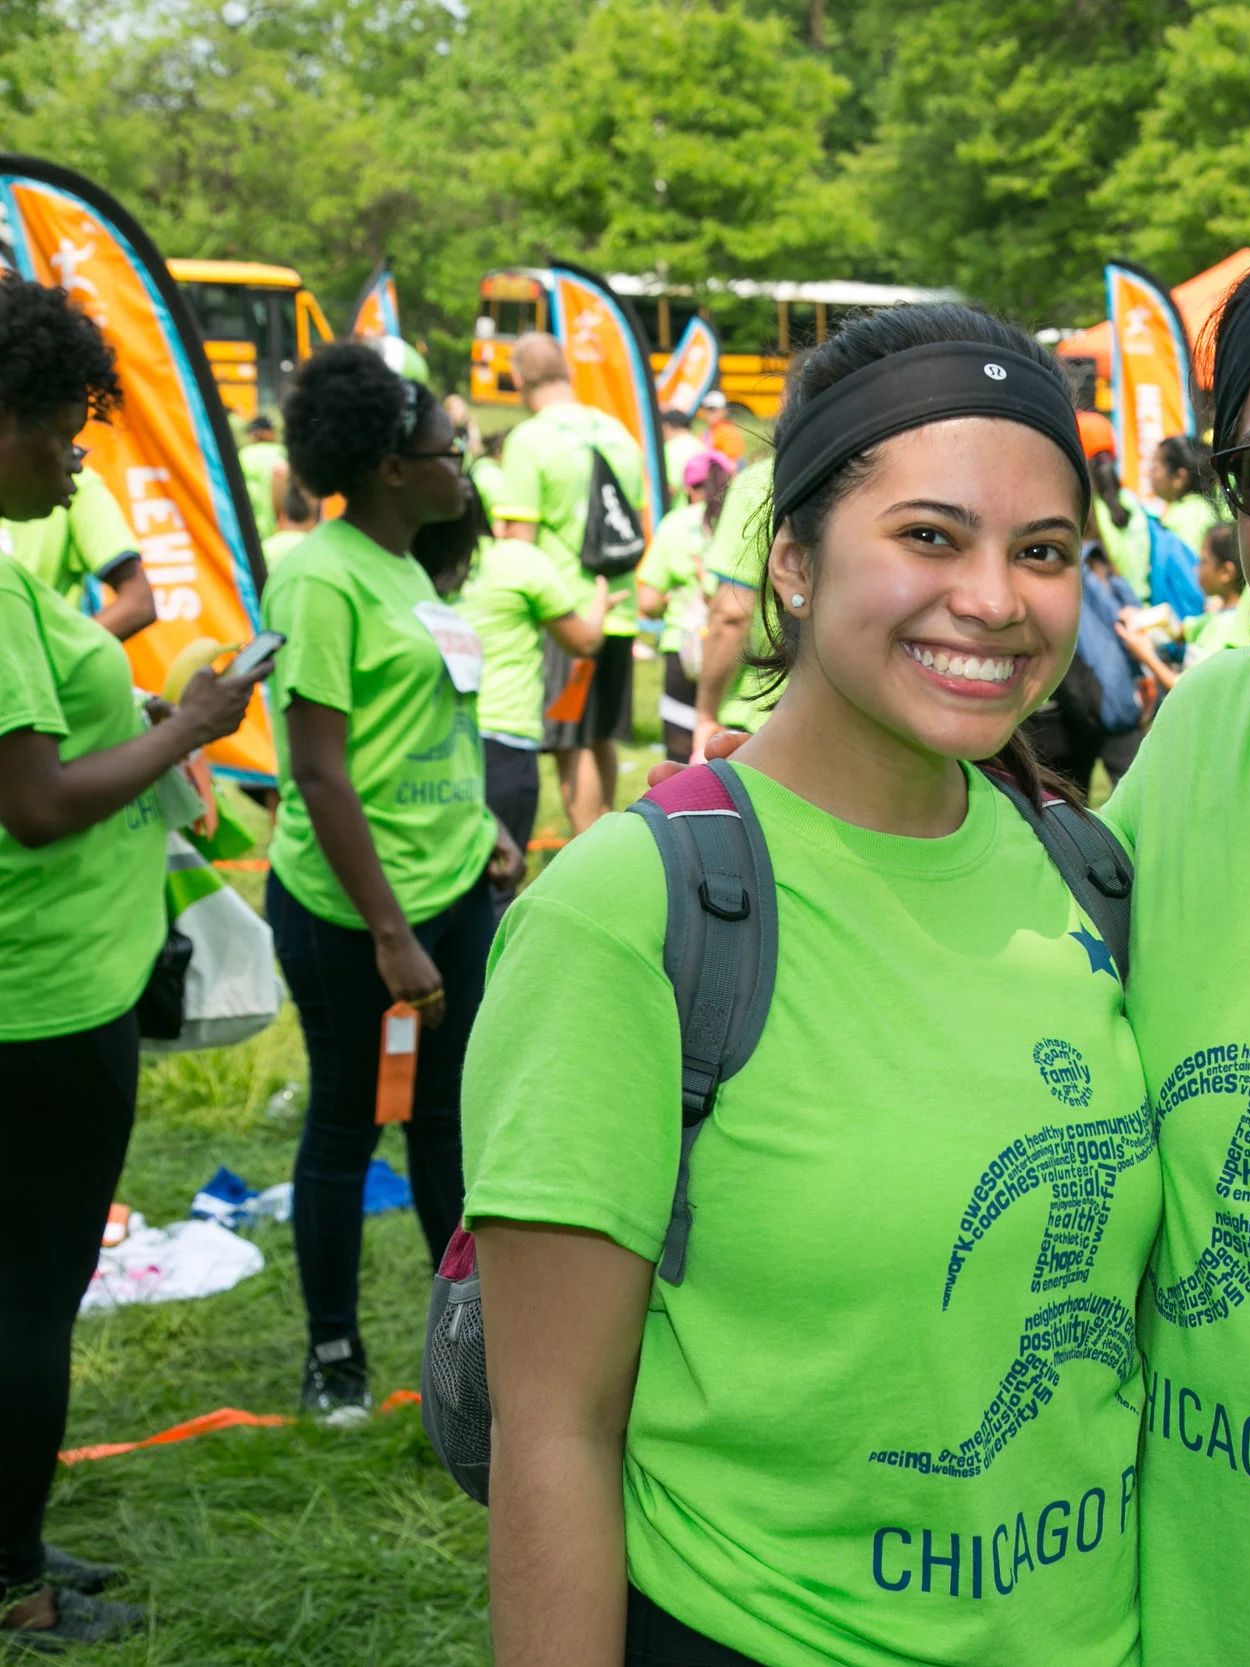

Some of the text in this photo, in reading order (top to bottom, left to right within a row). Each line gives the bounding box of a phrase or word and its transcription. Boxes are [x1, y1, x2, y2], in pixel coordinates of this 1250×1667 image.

[1041, 1049, 1070, 1066] team
[1042, 1038, 1082, 1061] inspire
[1040, 1059, 1090, 1084] family
[1160, 1043, 1238, 1101] awesome
[1051, 1087, 1093, 1107] strength
[1165, 1072, 1238, 1112] coaches
[1025, 1125, 1064, 1149] healthy
[1066, 1110, 1144, 1140] community
[1008, 1143, 1055, 1181] entertaining
[1036, 1152, 1077, 1172] resilience
[1055, 1140, 1075, 1156] run
[1077, 1136, 1125, 1165] goals
[1041, 1165, 1094, 1183] volunteer
[1216, 1136, 1244, 1198] super
[960, 1139, 1027, 1232] awesome
[1052, 1169, 1100, 1199] social
[972, 1167, 1040, 1240] coaches
[1085, 1162, 1117, 1267] powerful
[1048, 1206, 1095, 1233] health
[1053, 1231, 1090, 1249] athletic
[942, 1234, 976, 1312] teamwork
[1031, 1227, 1053, 1293] super
[1049, 1244, 1084, 1274] hope
[1042, 1267, 1090, 1291] energizing
[1216, 1271, 1245, 1307] fun
[1025, 1292, 1093, 1331] neighborhood
[1089, 1296, 1129, 1328] unity
[1020, 1313, 1090, 1357] positivity
[1025, 1353, 1060, 1387] active
[1026, 1374, 1053, 1405] fun
[960, 1359, 1029, 1456] mentoring
[983, 1379, 1028, 1449] inclusion
[984, 1398, 1038, 1469] diversity
[869, 1450, 932, 1474] pacing
[932, 1463, 981, 1478] wellness
[938, 1449, 982, 1468] great
[872, 1487, 1105, 1599] CHICAGO
